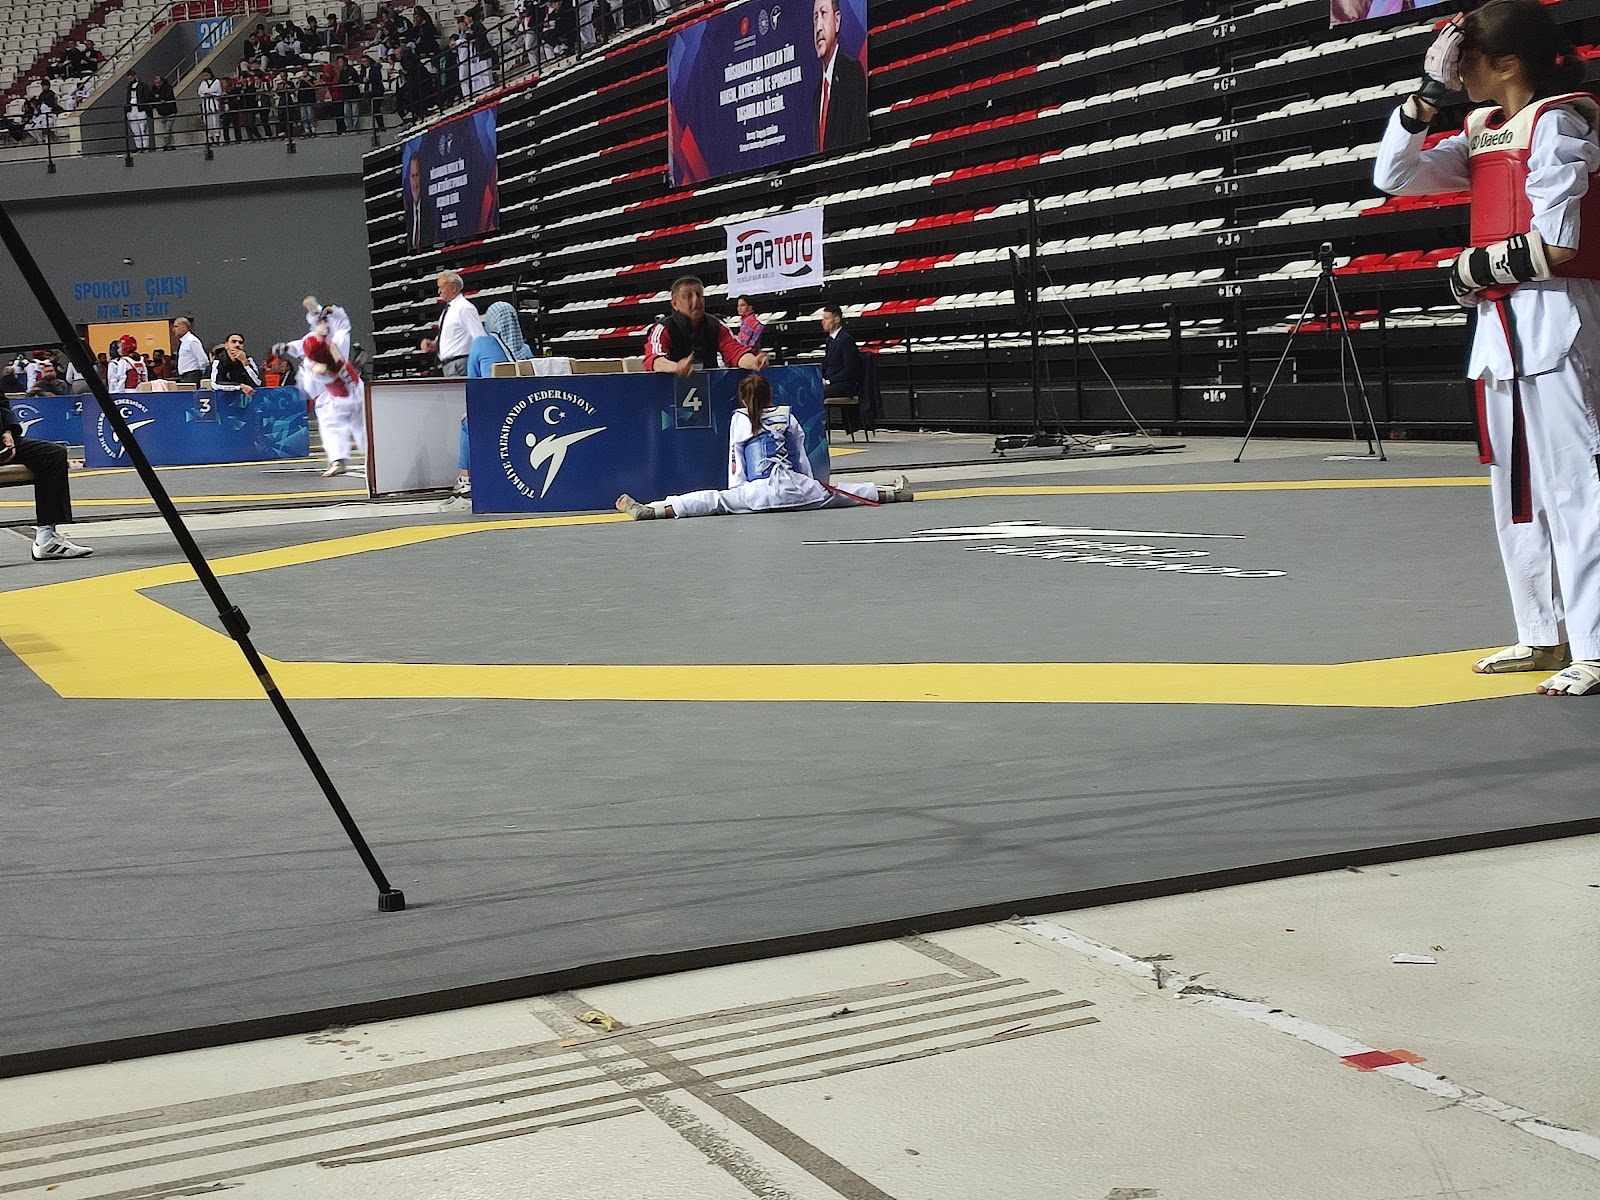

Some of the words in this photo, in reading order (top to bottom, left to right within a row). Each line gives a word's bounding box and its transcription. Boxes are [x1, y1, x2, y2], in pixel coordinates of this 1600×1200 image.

[1220, 24, 1228, 37] F
[1221, 78, 1229, 91] G
[1480, 129, 1513, 148] Daedo
[1225, 233, 1232, 246] J
[75, 280, 130, 300] SPORCU
[97, 303, 141, 319] ATHLETE
[145, 302, 170, 316] EXIT
[75, 402, 83, 412] 2
[199, 398, 211, 413] 3
[527, 389, 597, 416] FEDERASYONU
[682, 388, 702, 412] 4
